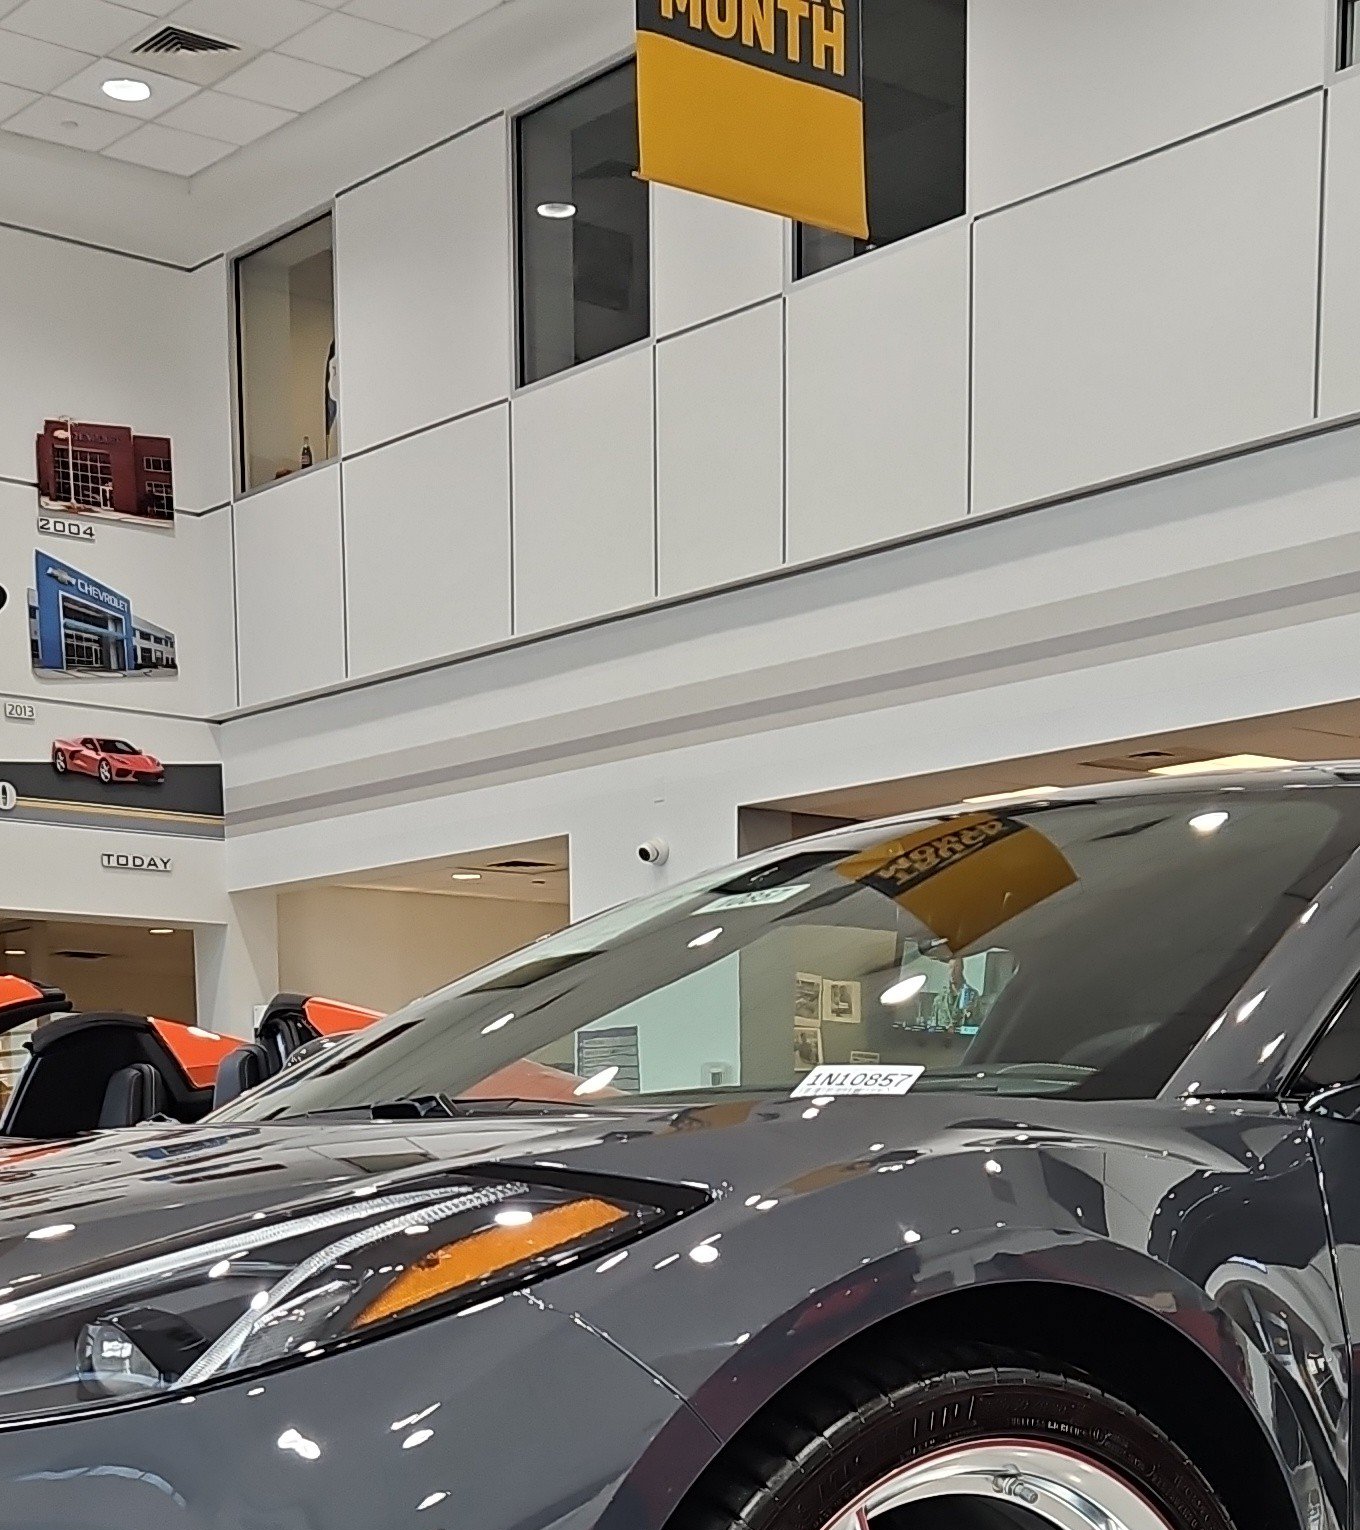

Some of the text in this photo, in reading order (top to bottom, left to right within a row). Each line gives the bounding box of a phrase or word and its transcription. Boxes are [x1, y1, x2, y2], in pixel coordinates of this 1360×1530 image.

[39, 518, 95, 538] 2004
[77, 578, 128, 613] CHEVROLET
[7, 703, 35, 718] 2013
[101, 853, 172, 870] TODAY
[806, 1072, 913, 1088] 1N10857
